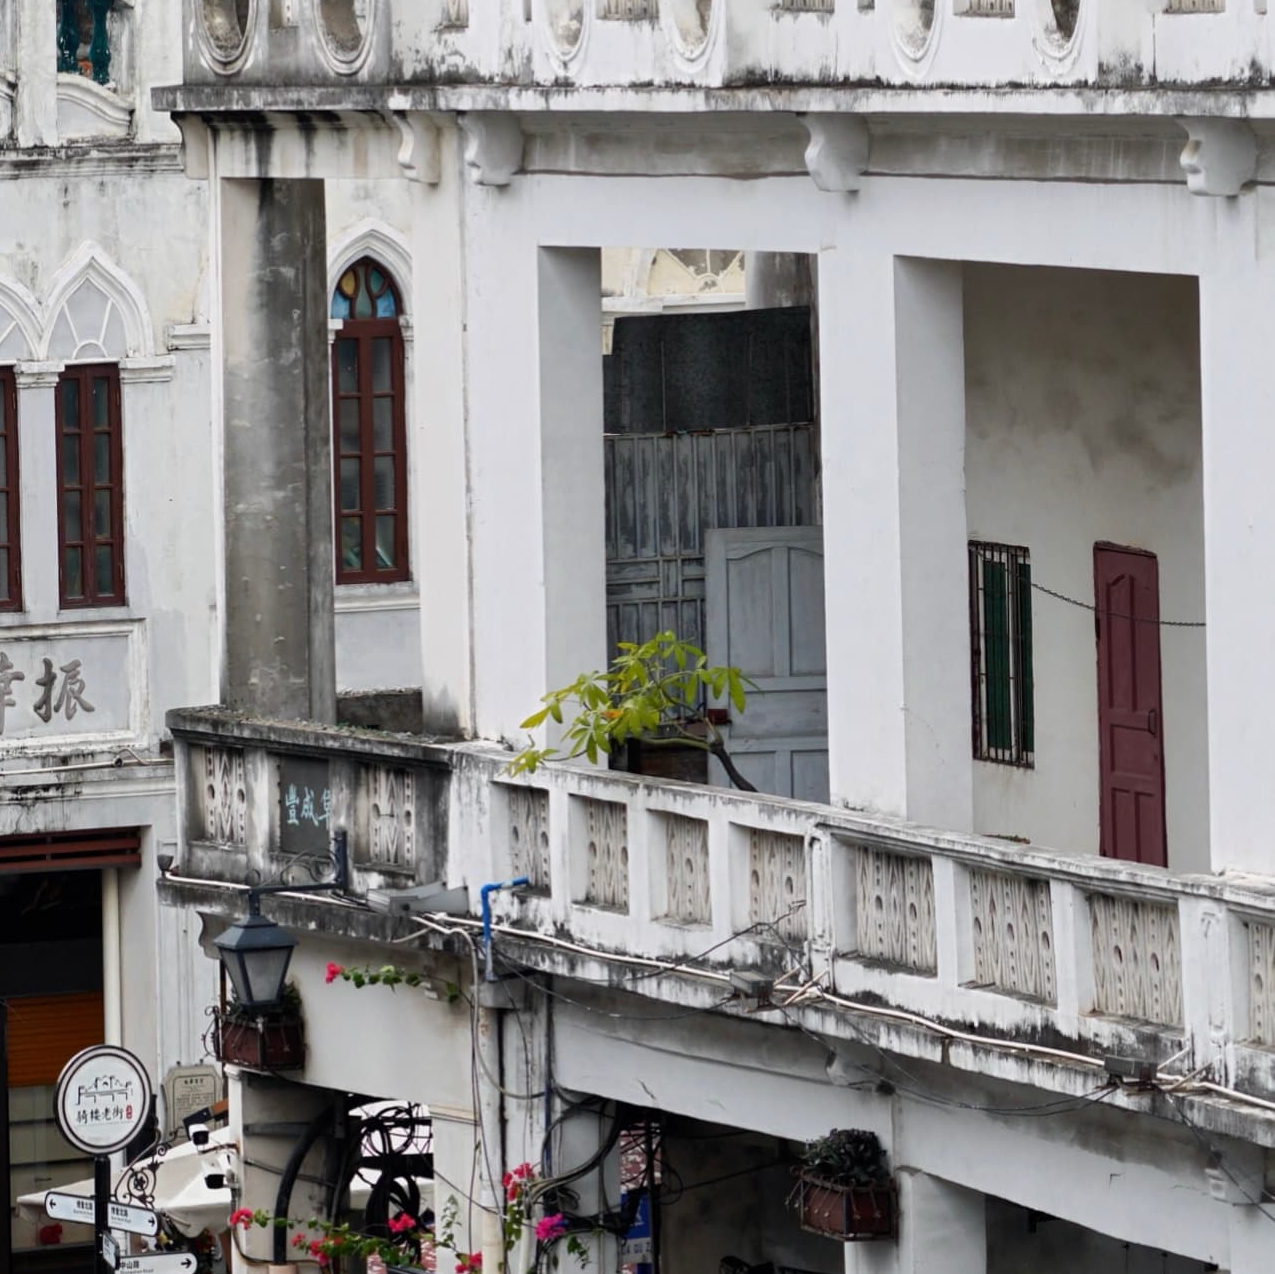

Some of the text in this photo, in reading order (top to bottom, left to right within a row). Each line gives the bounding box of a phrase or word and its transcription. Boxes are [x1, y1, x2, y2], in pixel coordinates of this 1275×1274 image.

[76, 1104, 124, 1124] 骑楼老街
[119, 1260, 140, 1270] 中山路
